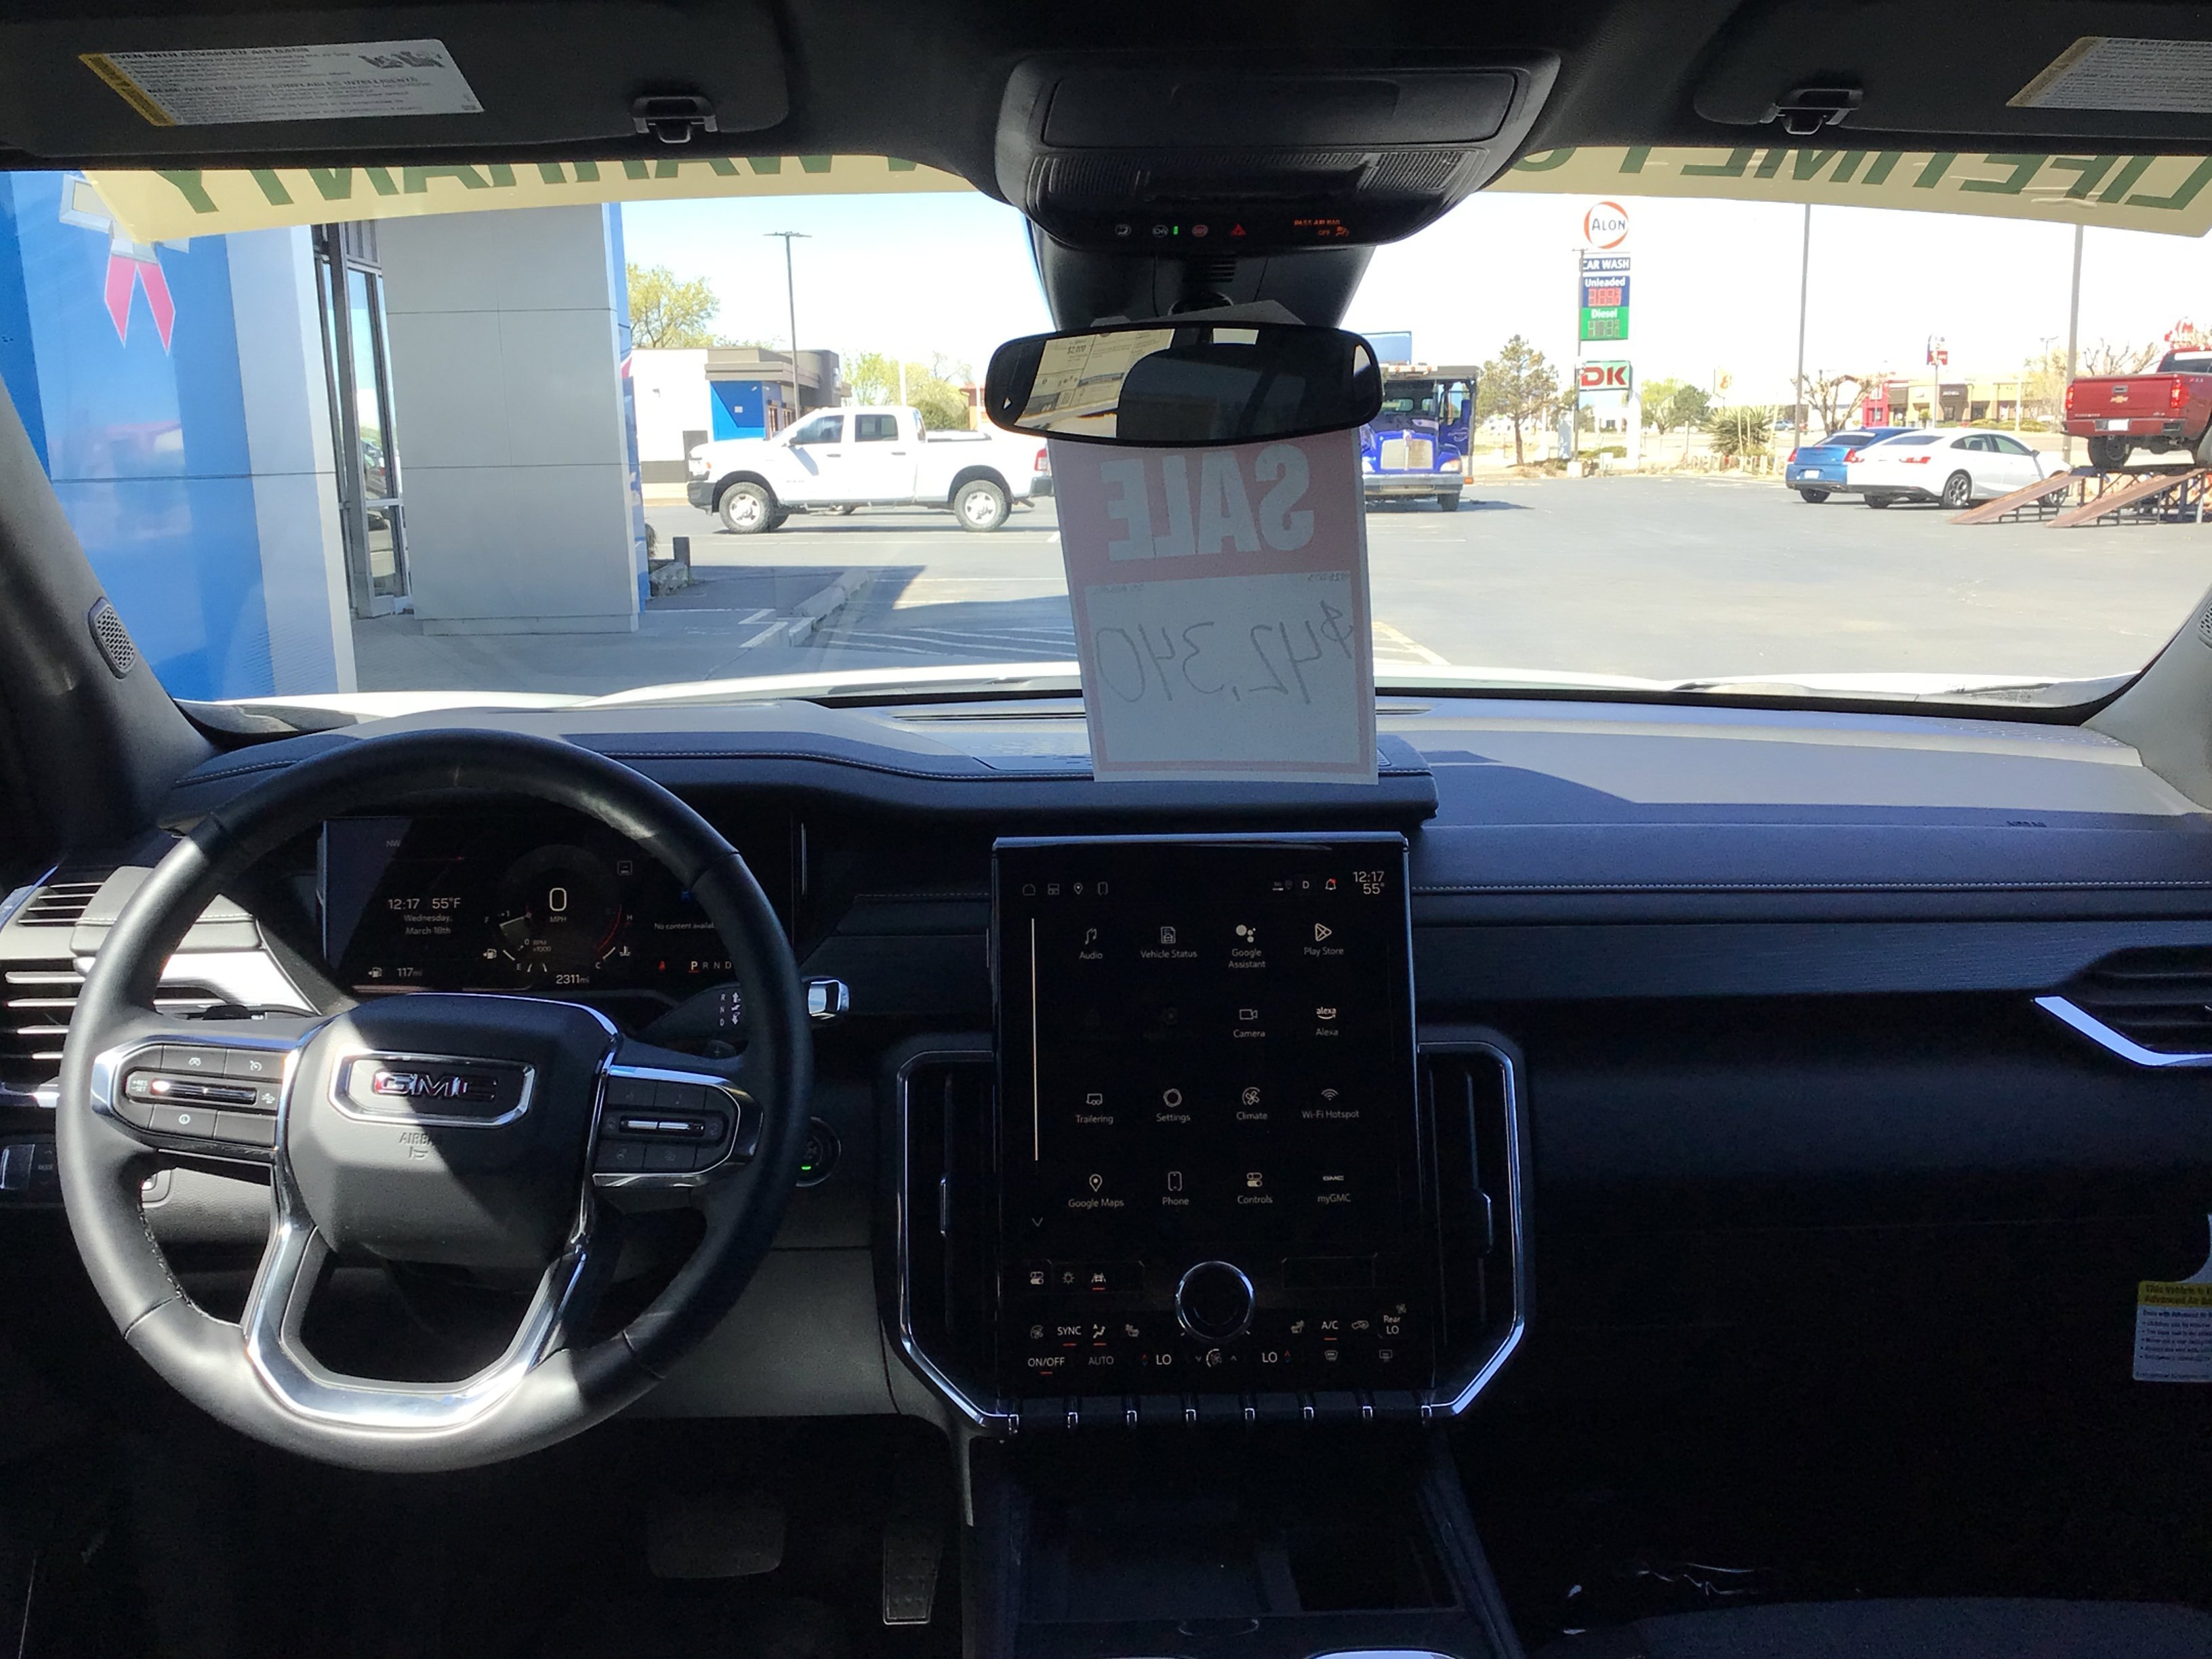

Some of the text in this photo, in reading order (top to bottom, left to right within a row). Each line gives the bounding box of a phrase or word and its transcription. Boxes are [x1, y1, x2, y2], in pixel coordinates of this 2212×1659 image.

[1592, 218, 1626, 231] ALON
[1601, 259, 1629, 270] WASH
[1584, 276, 1626, 287] Unleaded
[1591, 308, 1618, 319] Diesel
[1581, 366, 1626, 386] DK
[1353, 871, 1385, 883] 12:17
[1363, 882, 1385, 895] 55°
[388, 897, 462, 909] 12:17 55°F
[549, 887, 567, 912] 0
[405, 926, 451, 935] March 18th
[1079, 950, 1103, 960] Audio
[1140, 949, 1197, 959] Vehicle Status
[1231, 947, 1262, 960] Google
[1304, 946, 1344, 958] Play Store
[691, 961, 698, 970] P
[703, 961, 709, 969] R
[714, 961, 720, 969] N
[1228, 959, 1266, 970] Assistant
[1316, 1006, 1337, 1017] alexa
[1233, 1029, 1266, 1039] Camera
[1315, 1027, 1339, 1037] Alexa
[1076, 1113, 1114, 1125] Trailering
[1155, 1112, 1191, 1124] Settings
[1236, 1110, 1268, 1121] Climate
[1301, 1108, 1359, 1120] Wi-Fi Hotspot
[1068, 1196, 1124, 1209] Google Maps
[1162, 1195, 1189, 1206] Phone
[1237, 1194, 1273, 1205] Controls
[1317, 1192, 1351, 1204] myGMC
[1383, 1314, 1401, 1324] Rear
[1057, 1325, 1082, 1336] SYNC
[1321, 1320, 1339, 1331] A/C
[1386, 1325, 1399, 1334] LO
[1027, 1356, 1065, 1368] ON/OFF
[1088, 1355, 1115, 1366] AUTO
[1155, 1354, 1172, 1366] LO
[1262, 1351, 1278, 1363] LO
